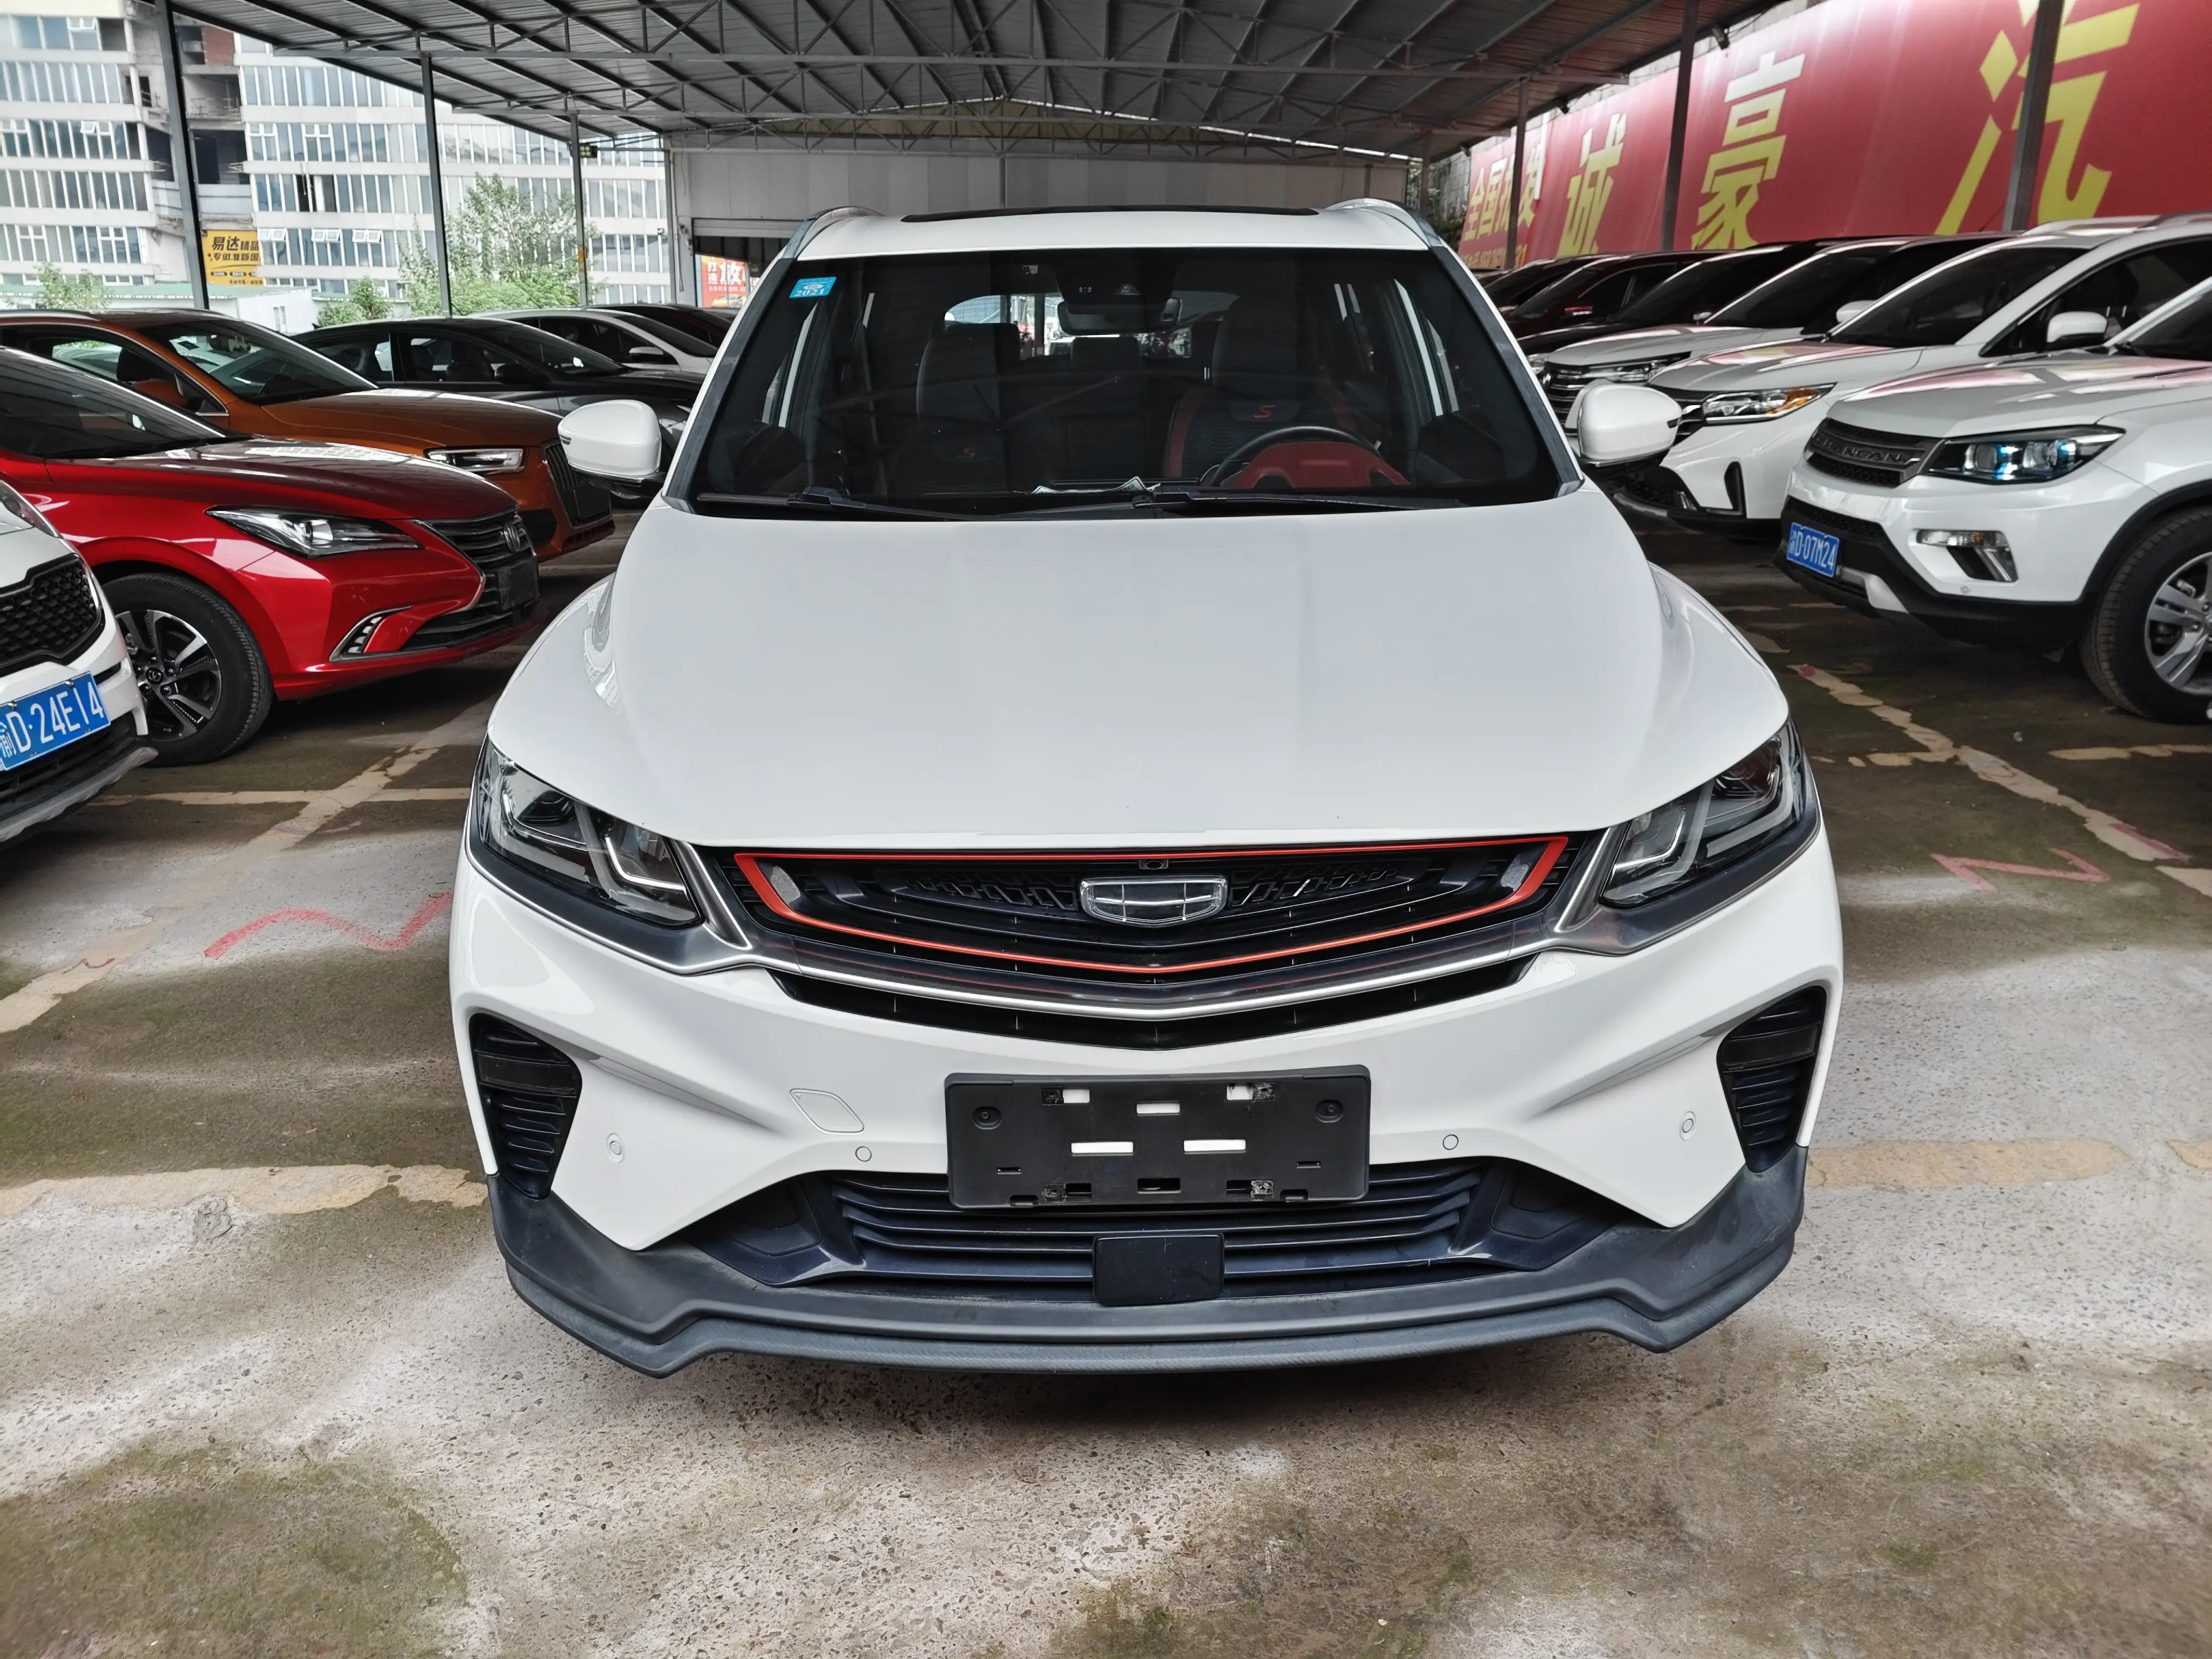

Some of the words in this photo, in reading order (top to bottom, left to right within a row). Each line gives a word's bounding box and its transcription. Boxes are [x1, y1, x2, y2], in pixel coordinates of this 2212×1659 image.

[213, 253, 260, 261] 专做准新国
[793, 288, 825, 296] 2021
